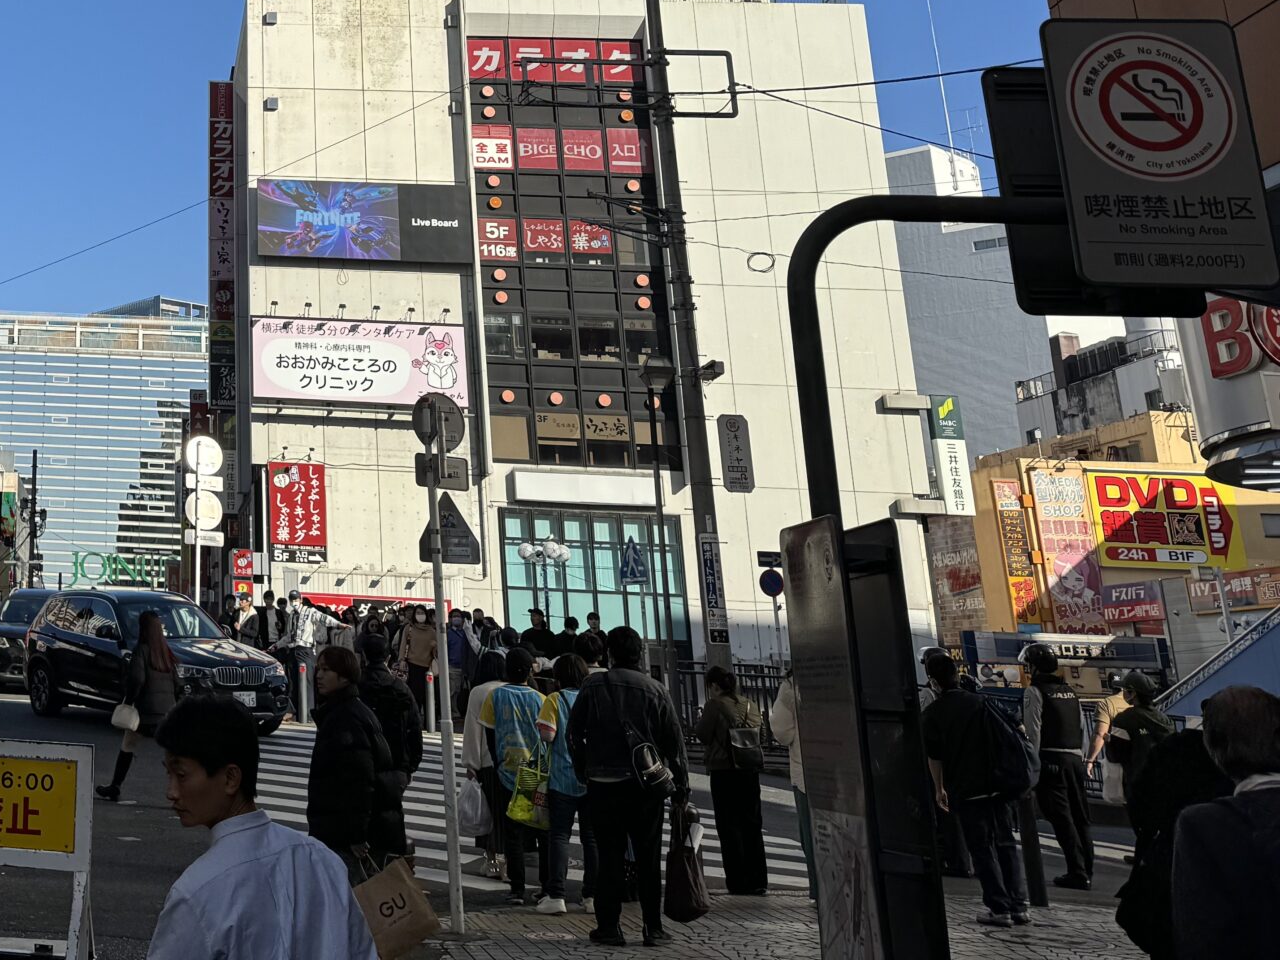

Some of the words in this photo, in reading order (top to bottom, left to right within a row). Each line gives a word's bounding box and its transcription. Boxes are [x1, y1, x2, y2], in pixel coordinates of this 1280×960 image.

[471, 46, 638, 75] カラオケ
[1082, 48, 1126, 97] 喫煙禁止地区
[1136, 45, 1153, 56] No
[1155, 48, 1199, 77] Smoking
[1196, 76, 1215, 99] Area
[474, 141, 510, 155] 全室
[611, 143, 638, 157] 入口
[1105, 141, 1136, 163] 横浜市
[1146, 160, 1163, 170] City
[1165, 159, 1175, 169] of
[1175, 141, 1214, 168] Yokohama
[212, 121, 234, 197] カラオケ
[476, 155, 509, 165] DAM
[1084, 194, 1257, 221] 喫煙禁止地区
[295, 208, 361, 227] FORTNITE
[411, 217, 431, 227] Live
[431, 218, 459, 228] Board
[523, 222, 563, 232] しゃぶしゃぶ
[485, 222, 510, 240] 5F
[1119, 223, 1137, 234] No
[1140, 223, 1196, 237] Smoking
[1198, 224, 1228, 236] Area
[480, 244, 518, 258] 116席
[294, 341, 371, 354] 精神科・心療内科専門
[275, 353, 398, 374] おおかみこころの
[299, 373, 375, 393] クリニック
[536, 414, 549, 423] 3F
[939, 419, 957, 427] SMBC
[946, 442, 965, 512] 三井住友銀行
[1049, 477, 1081, 488] MEDIA
[307, 465, 322, 537] しゃぶしゃぶ
[1094, 475, 1198, 510] DVD
[275, 492, 292, 542] しゃぶ葉
[291, 480, 308, 543] バイキング
[1043, 505, 1083, 517] SHOP
[1099, 509, 1171, 545] 鑑賞
[1203, 495, 1227, 549] コチラ
[274, 550, 290, 562] 5F
[1117, 548, 1149, 561] 24h
[1168, 551, 1195, 562] B1F
[63, 550, 180, 588] JOINU
[1111, 585, 1146, 602] ドスパラ
[1104, 604, 1160, 621] パソコン専門店
[379, 892, 407, 918] GU
